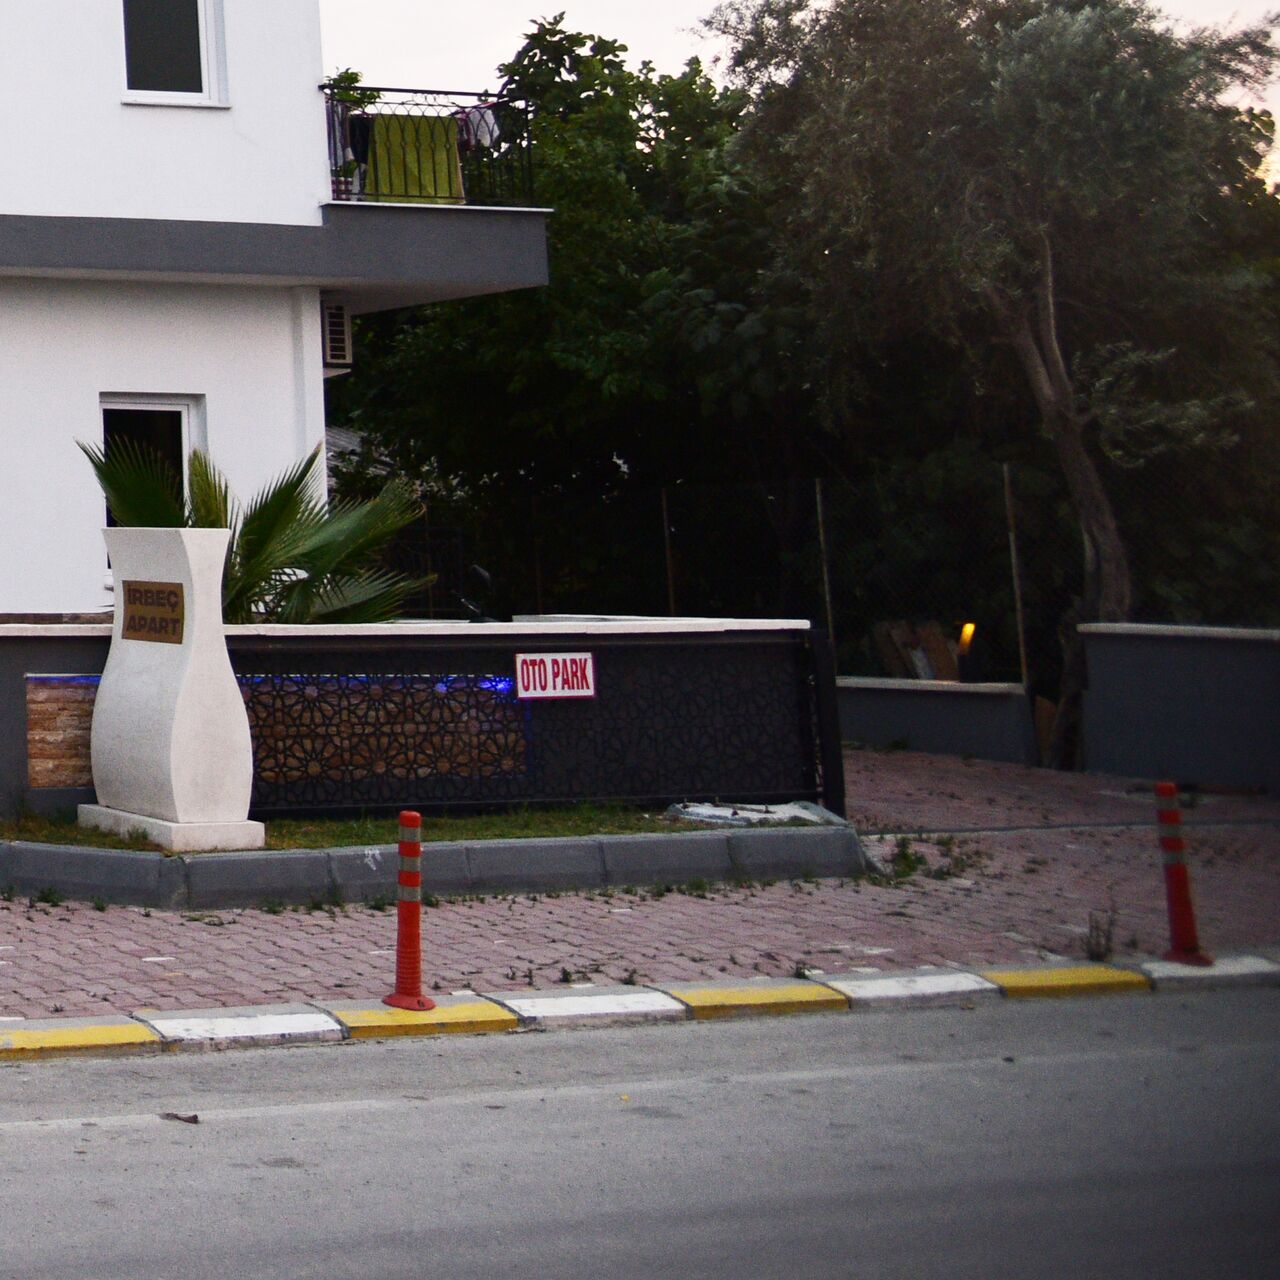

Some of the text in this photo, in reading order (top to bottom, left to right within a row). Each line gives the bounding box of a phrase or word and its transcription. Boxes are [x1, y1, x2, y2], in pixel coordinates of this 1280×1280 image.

[126, 615, 181, 636] APART
[520, 658, 590, 692] OTO PARK
